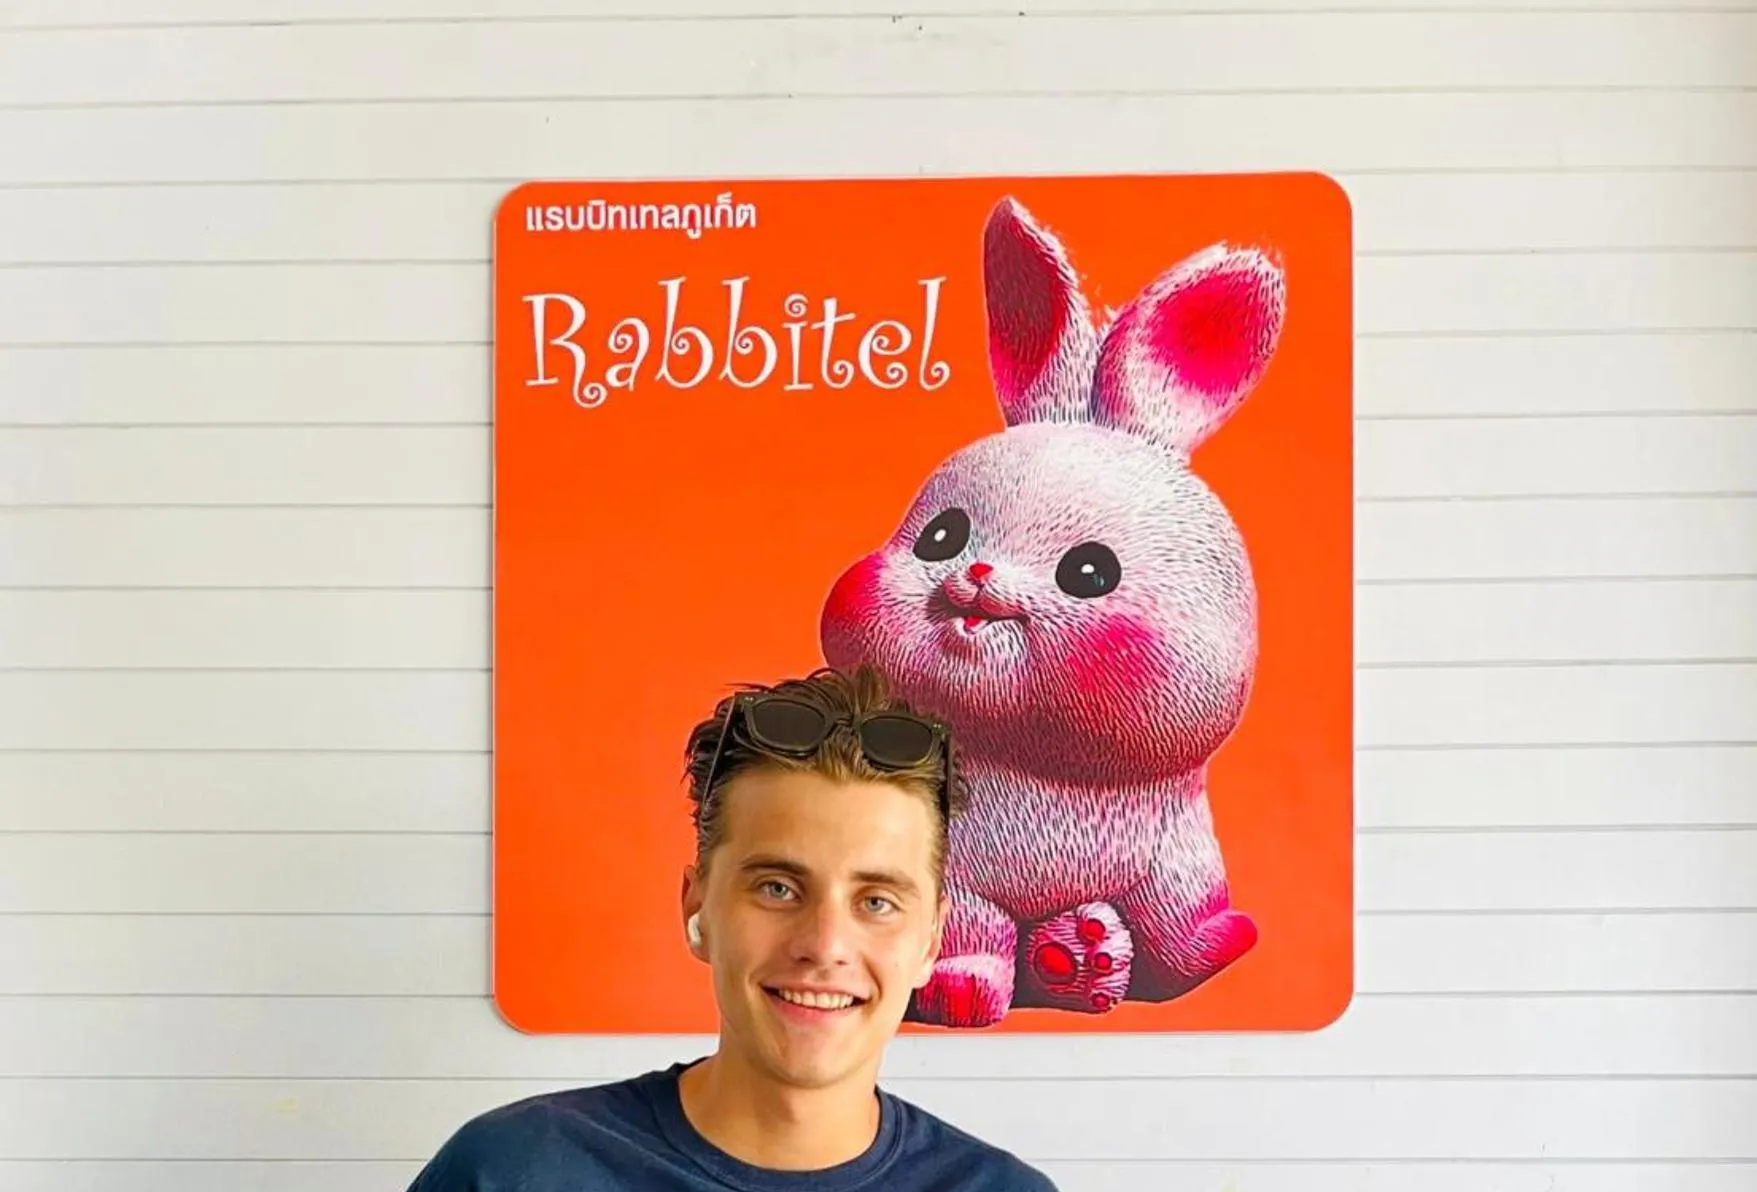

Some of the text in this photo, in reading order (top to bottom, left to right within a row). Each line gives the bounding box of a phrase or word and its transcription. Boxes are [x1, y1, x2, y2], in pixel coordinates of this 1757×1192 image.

[525, 191, 757, 240] แรบบิทเทลภูเก็ต
[522, 275, 951, 409] Rabbitel
